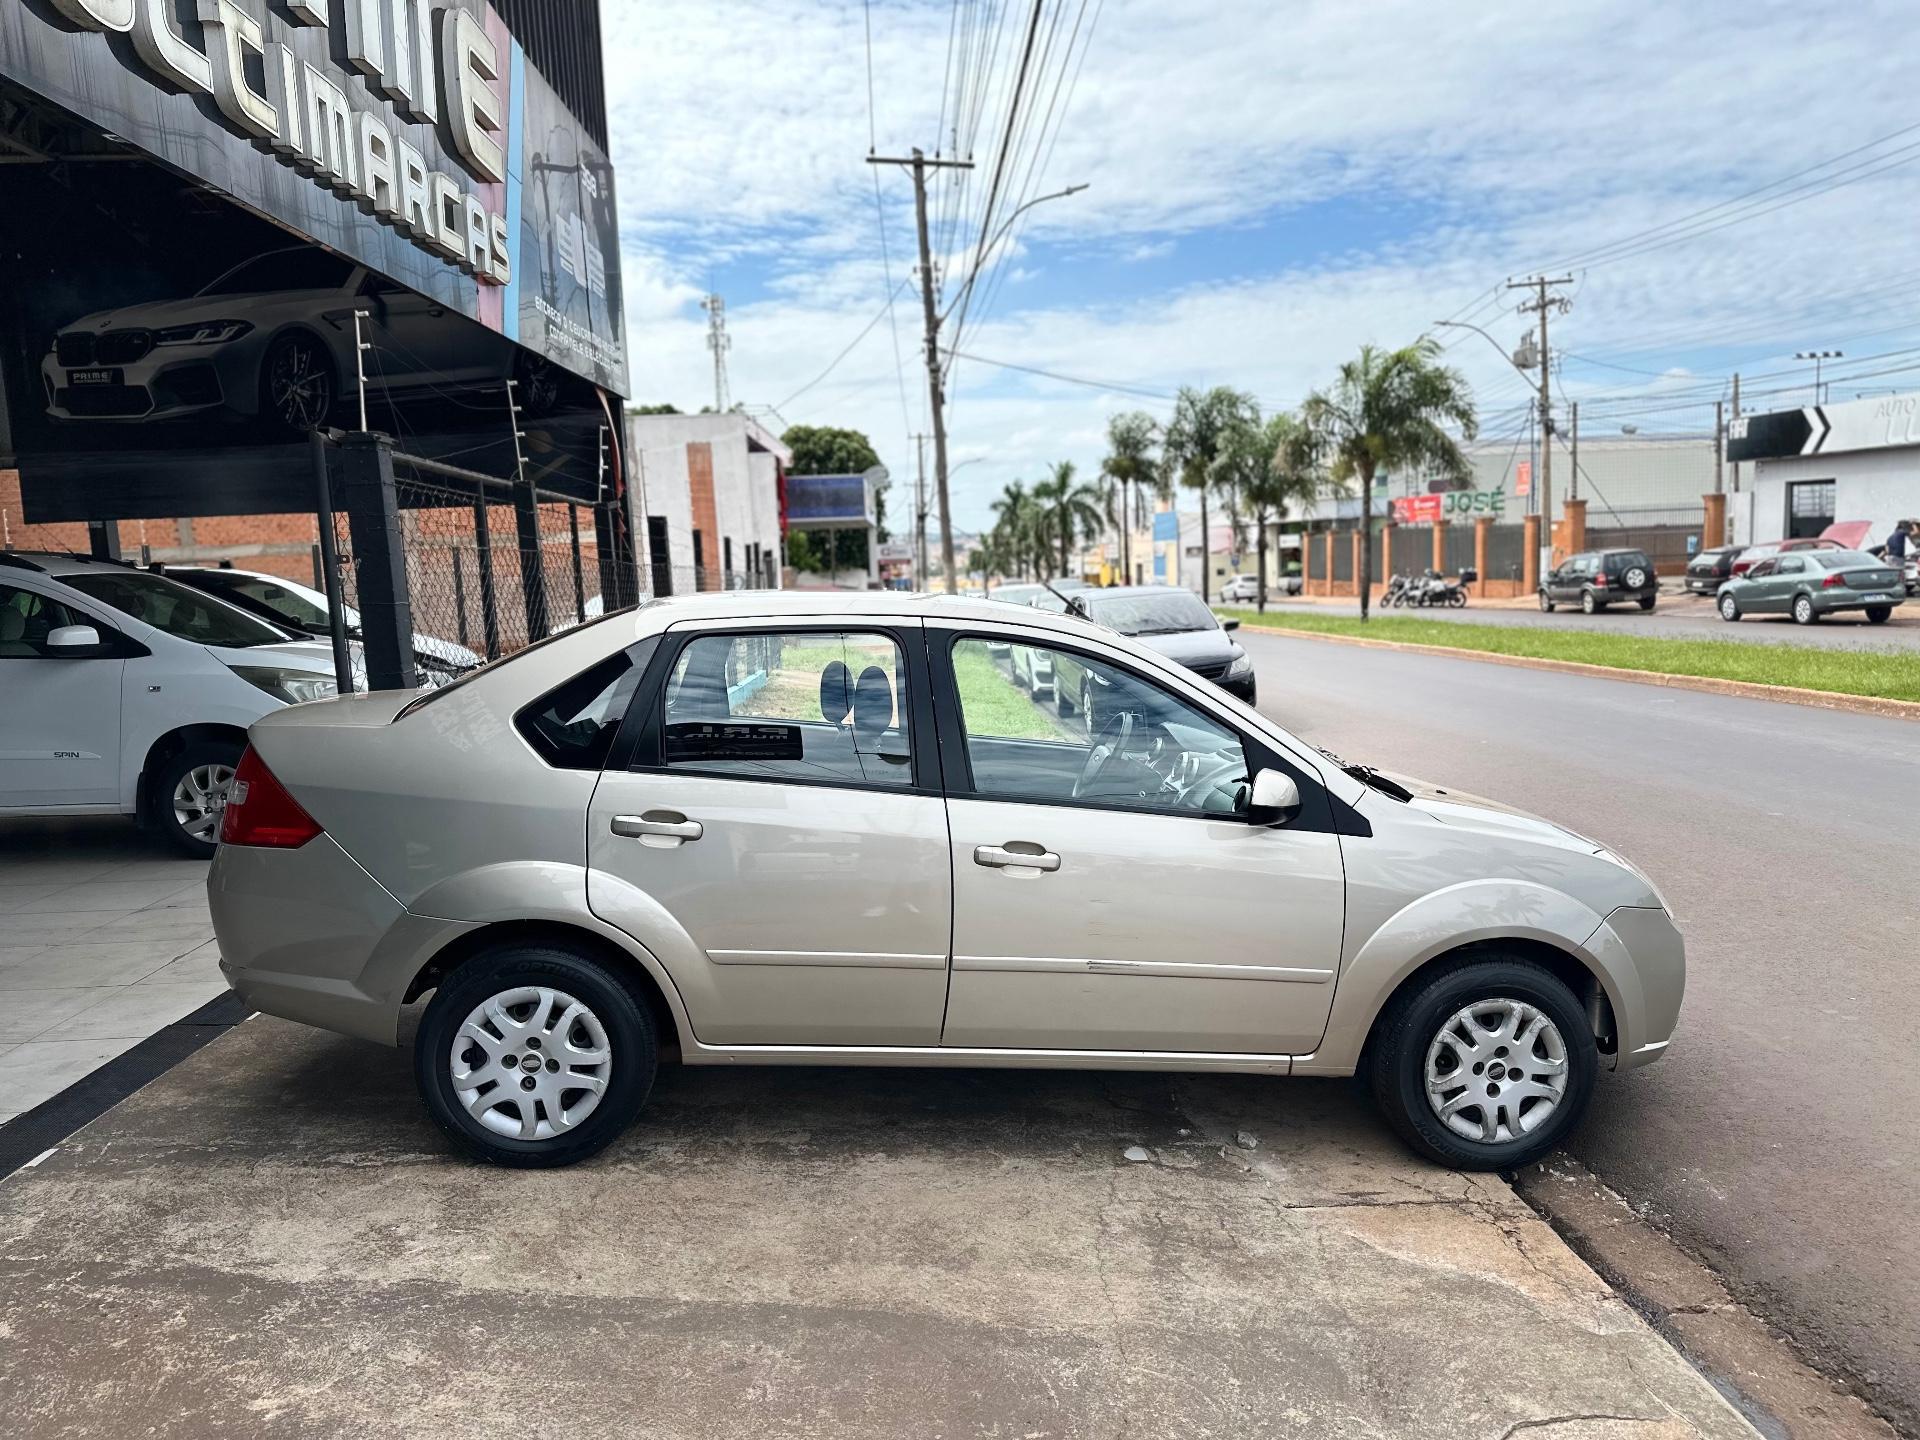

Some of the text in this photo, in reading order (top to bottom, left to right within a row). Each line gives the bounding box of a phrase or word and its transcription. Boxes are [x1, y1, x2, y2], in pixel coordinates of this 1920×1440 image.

[73, 372, 108, 380] PRIME
[1729, 419, 1749, 440] FIAT
[1445, 486, 1505, 513] JOSÉ
